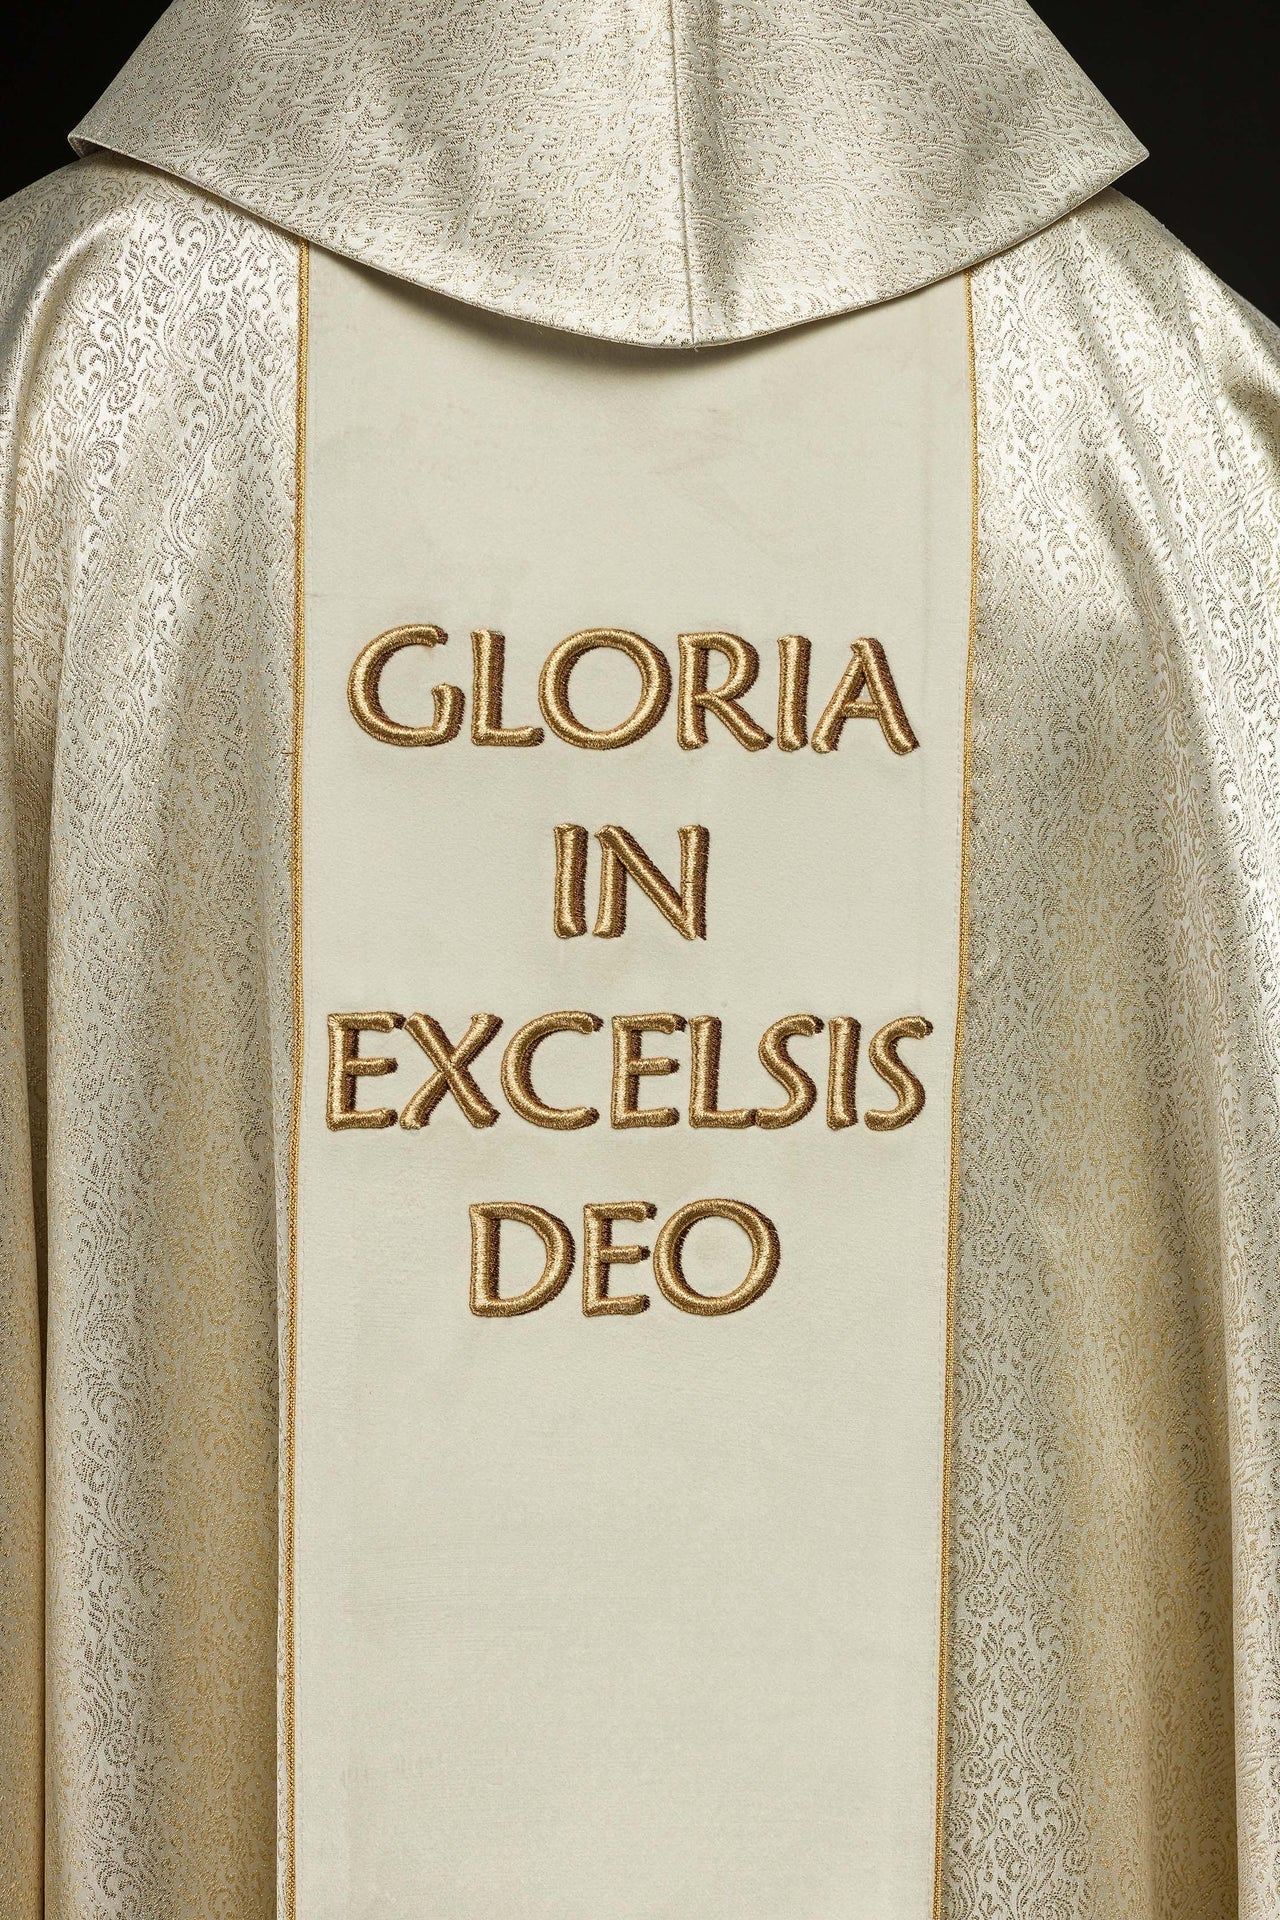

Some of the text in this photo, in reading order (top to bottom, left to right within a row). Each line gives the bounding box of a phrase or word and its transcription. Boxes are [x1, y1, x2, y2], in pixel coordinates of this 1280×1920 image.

[347, 624, 920, 755] GLORIA
[553, 823, 710, 940] IN
[325, 1010, 933, 1132] EXCELSIS
[469, 1198, 781, 1318] DEO
